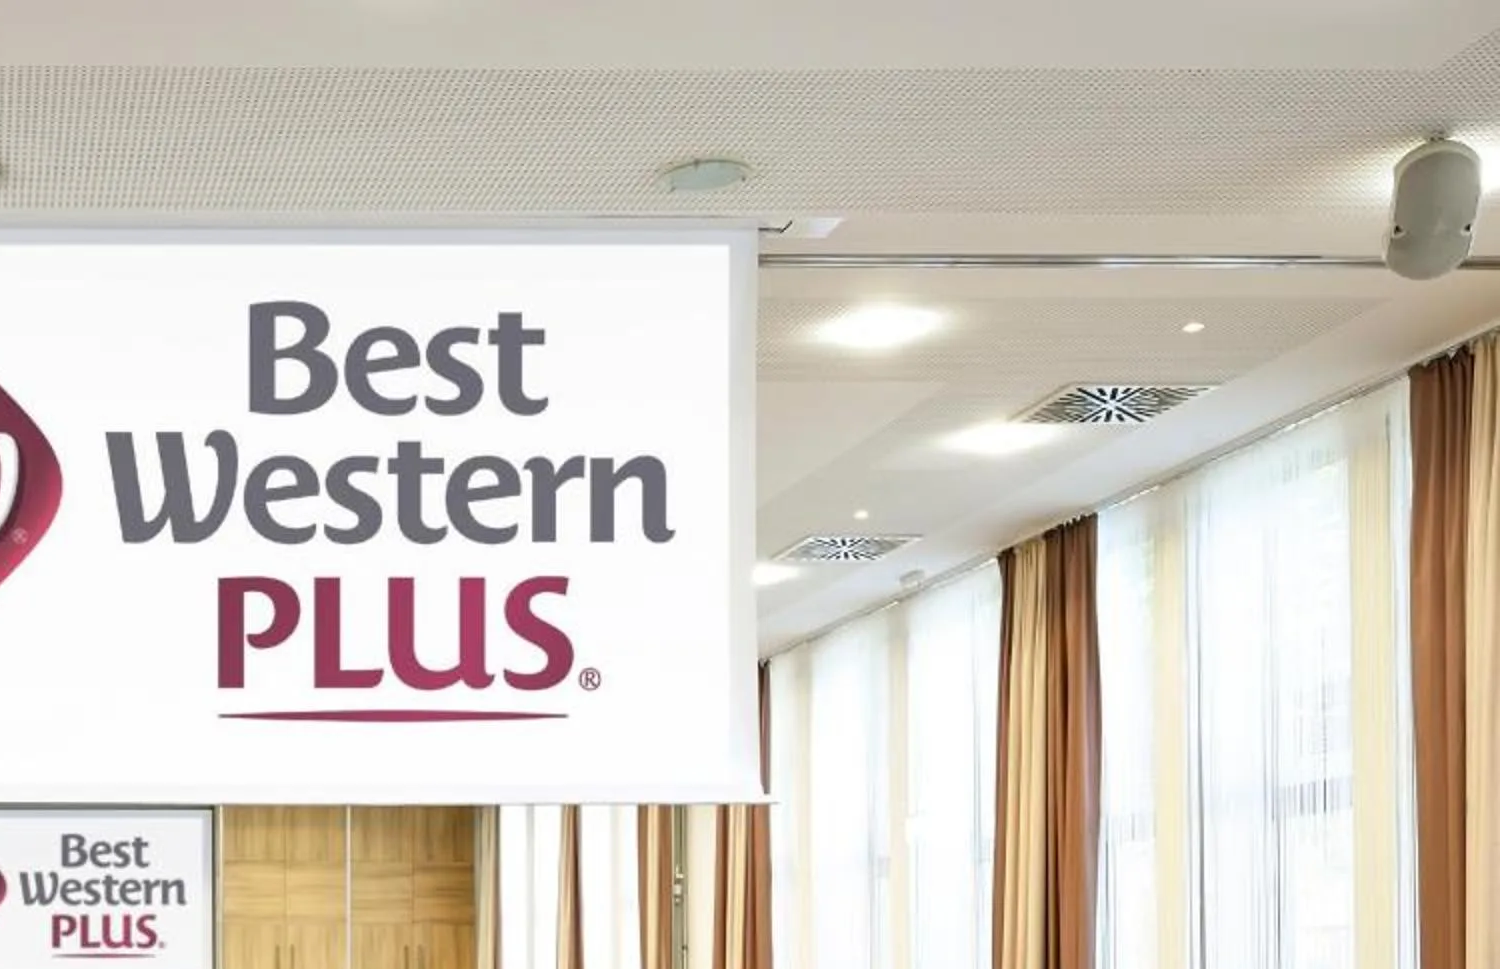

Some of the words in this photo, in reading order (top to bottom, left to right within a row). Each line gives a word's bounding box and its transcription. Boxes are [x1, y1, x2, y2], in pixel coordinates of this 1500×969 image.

[249, 300, 549, 416] Best
[105, 429, 676, 545] Western
[60, 833, 149, 868] Best
[19, 871, 187, 907] Western
